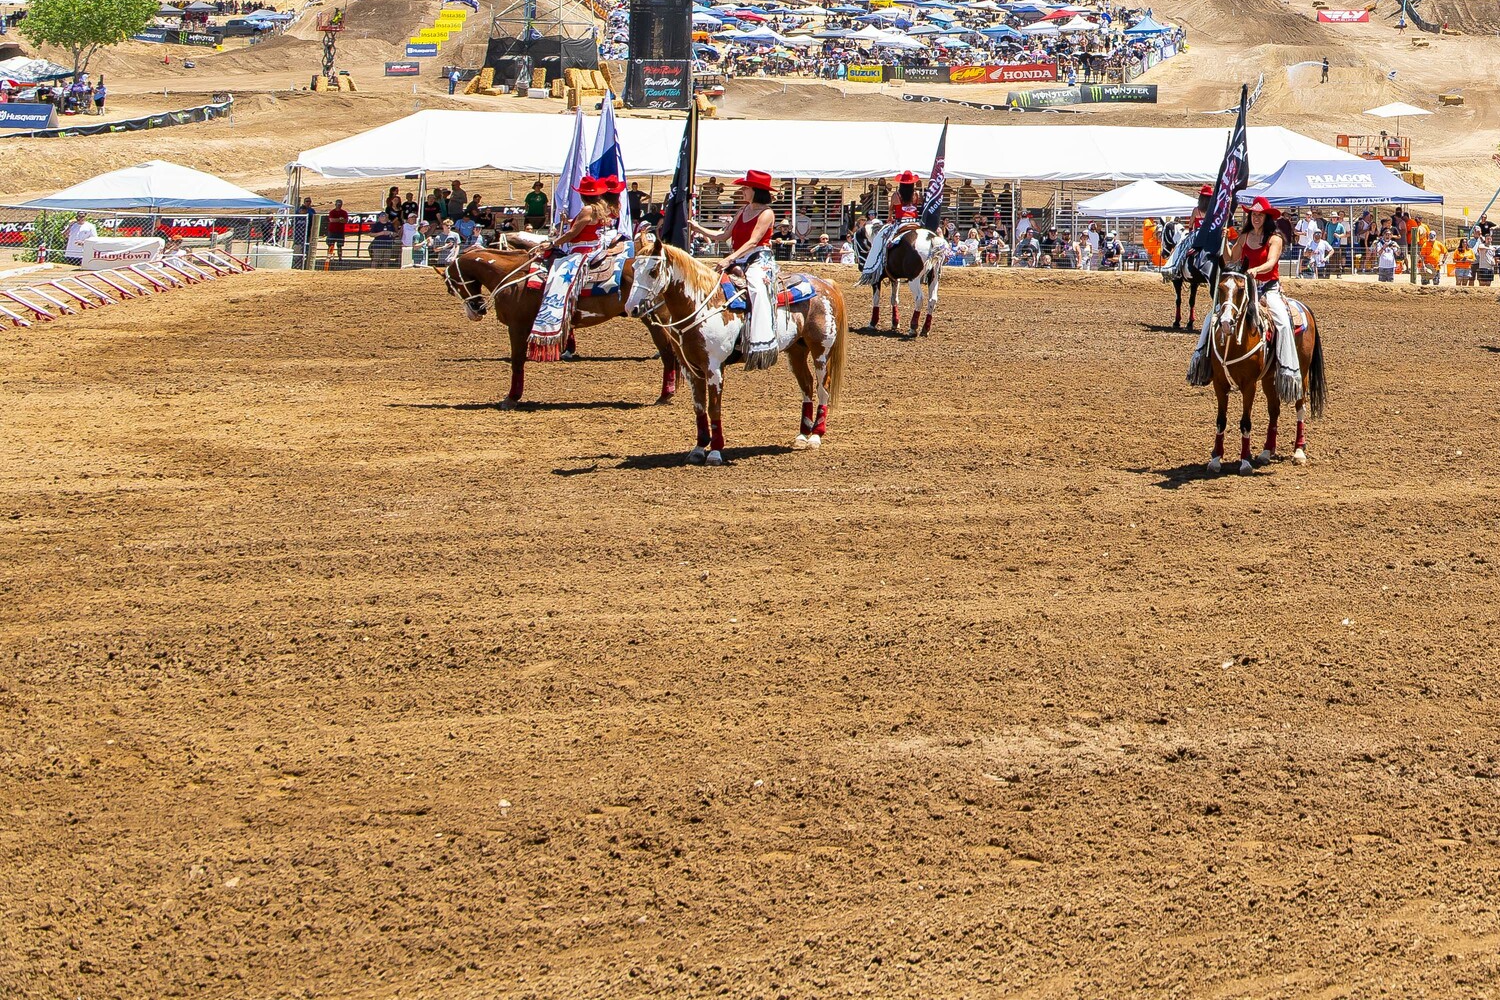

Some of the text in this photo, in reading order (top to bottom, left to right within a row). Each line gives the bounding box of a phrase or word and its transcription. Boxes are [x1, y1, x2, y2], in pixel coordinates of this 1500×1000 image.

[1319, 10, 1367, 19] FLY
[850, 69, 880, 77] SUZUKI
[904, 68, 938, 76] MONSTER
[951, 67, 985, 81] FMF
[1003, 69, 1053, 79] HONDA
[1032, 90, 1074, 99] MONSTER
[1104, 87, 1150, 95] MONSTER
[6, 113, 48, 122] Husqvarna
[1305, 174, 1373, 183] PARAGON
[1307, 197, 1342, 205] PARAGON
[92, 250, 152, 261] Hangtown
